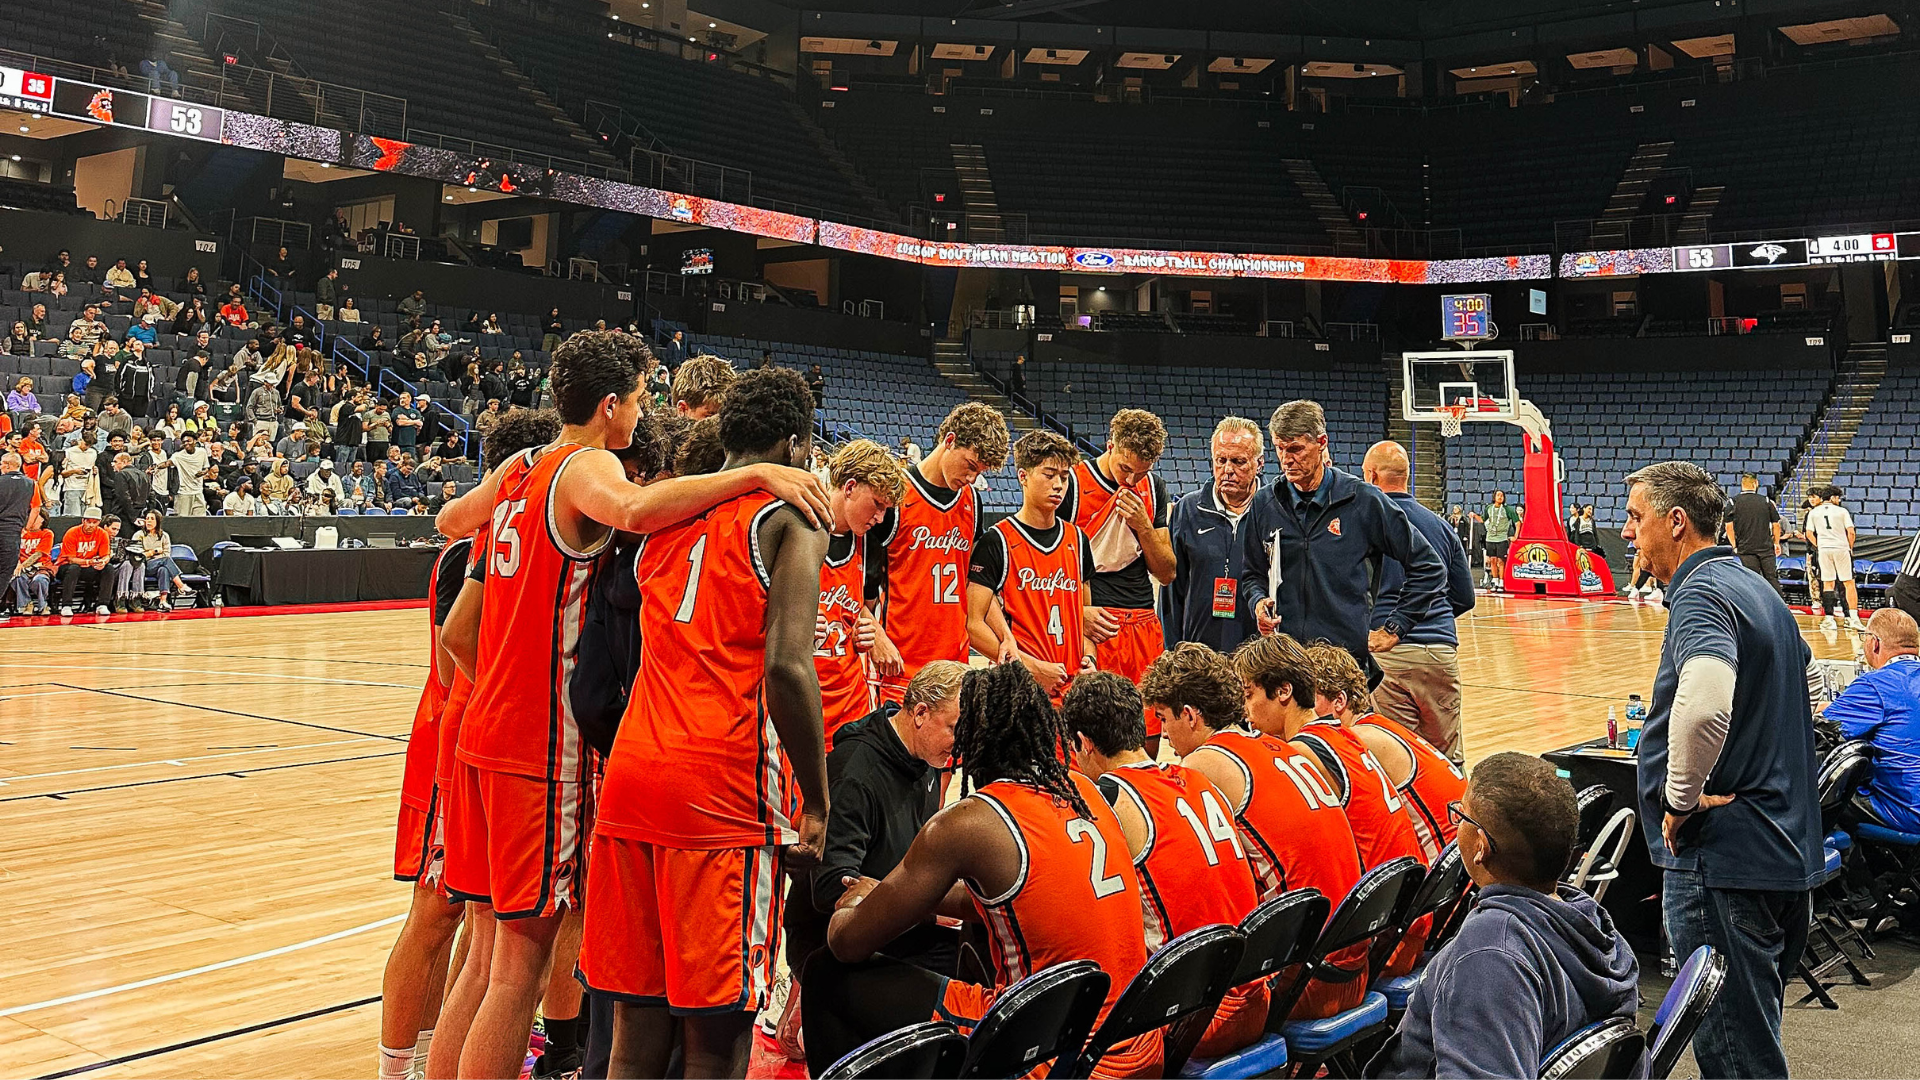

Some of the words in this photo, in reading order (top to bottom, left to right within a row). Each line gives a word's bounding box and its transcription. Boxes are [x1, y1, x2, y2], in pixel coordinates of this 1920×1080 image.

[28, 78, 45, 94] 35
[171, 105, 202, 135] 53
[939, 248, 1009, 263] SOUTHERN
[1011, 250, 1067, 265] SECTION
[1689, 249, 1713, 267] 53
[1833, 239, 1859, 251] 4:00
[1875, 237, 1890, 248] 35
[1082, 253, 1109, 266] Ford
[1123, 255, 1206, 270] BASKETBALL
[1208, 258, 1305, 273] CHAMPIONSHIPS
[1454, 298, 1484, 311] 4:00
[1453, 312, 1479, 336] 35
[1823, 515, 1832, 530] 1
[489, 498, 528, 578] 15
[908, 525, 970, 555] Pacifica
[1528, 547, 1548, 563] CIF
[674, 533, 708, 624] 1
[931, 562, 960, 604] 12
[1017, 566, 1078, 597] Pacifica
[818, 583, 861, 614] cifica
[1047, 604, 1064, 646] 4
[1274, 753, 1342, 811] 10
[1175, 789, 1245, 868] 14
[1066, 816, 1127, 900] 2
